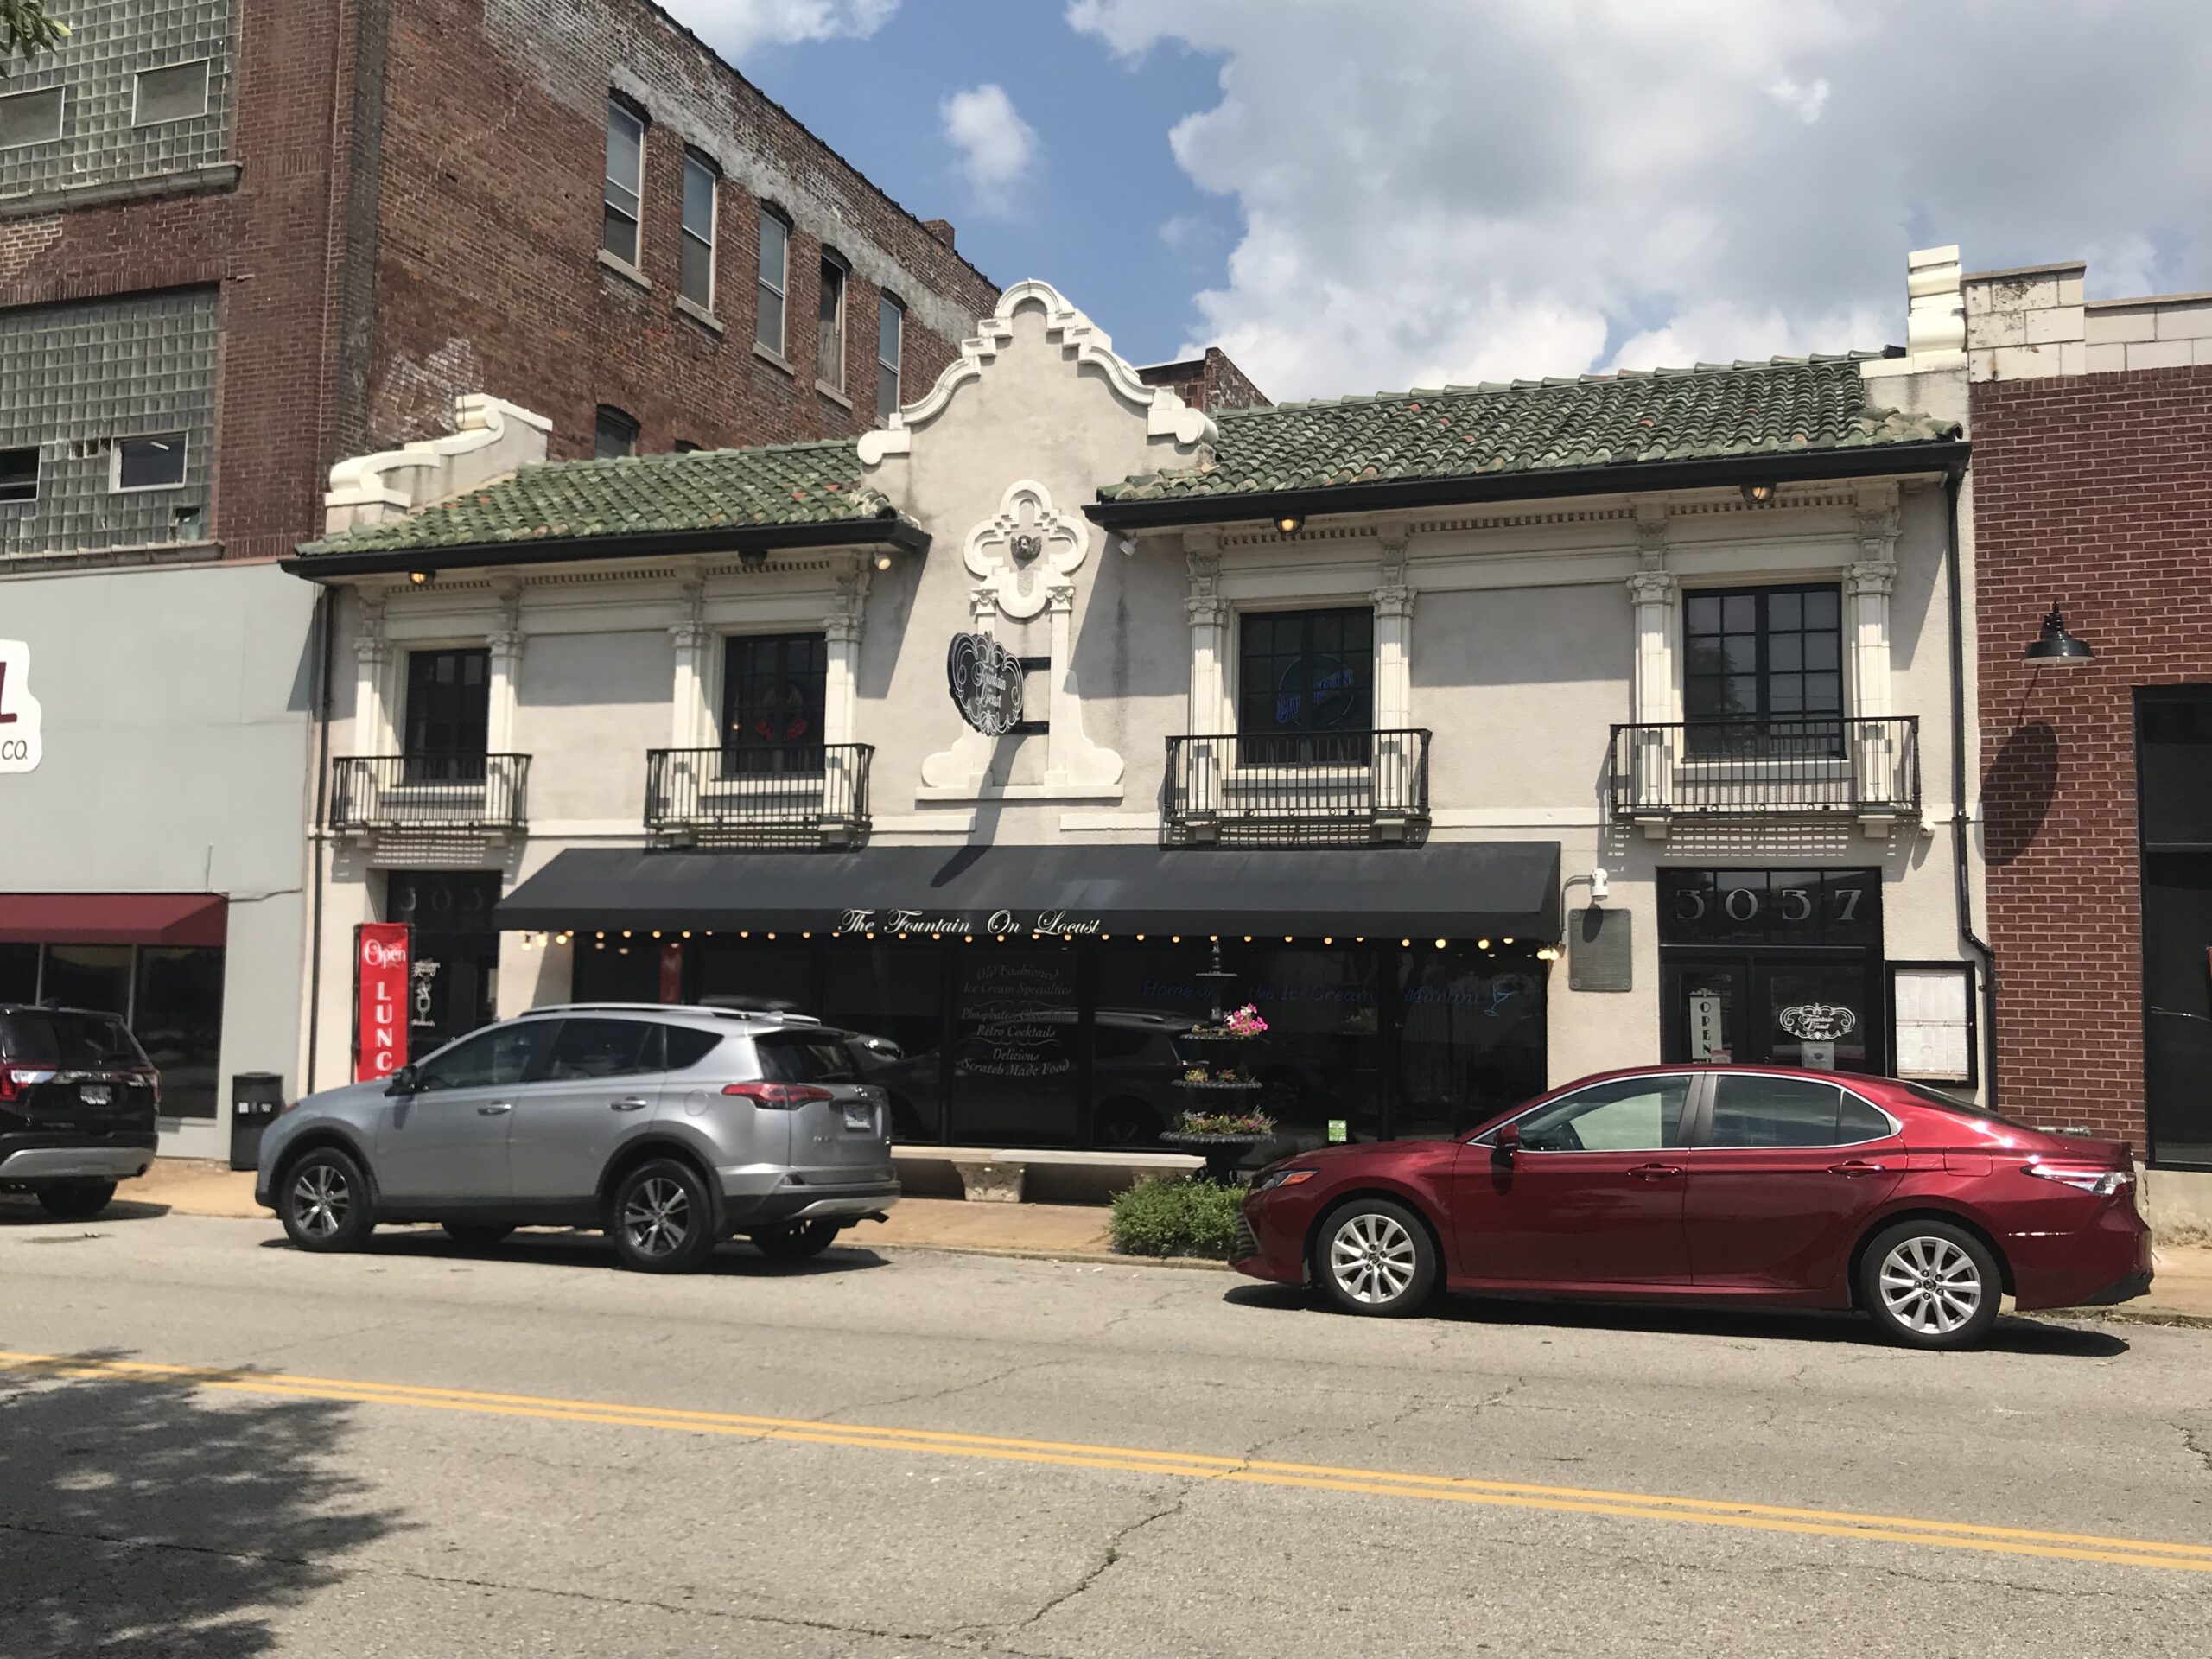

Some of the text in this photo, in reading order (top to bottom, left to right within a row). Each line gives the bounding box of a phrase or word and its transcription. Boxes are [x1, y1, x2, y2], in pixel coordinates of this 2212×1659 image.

[837, 909, 1100, 936] The Fountain On Locust
[364, 938, 406, 969] Open
[976, 963, 1059, 981] Old Fashioned
[963, 981, 1072, 997] Ice Cream Specialties
[1142, 981, 1193, 996] Home
[375, 981, 393, 1080] LUNC
[976, 1024, 1057, 1038] Retro Cocktails
[1700, 1001, 1712, 1055] OPEN
[992, 1048, 1039, 1062] Delicious
[961, 1058, 1070, 1077] Scratch Made Food
